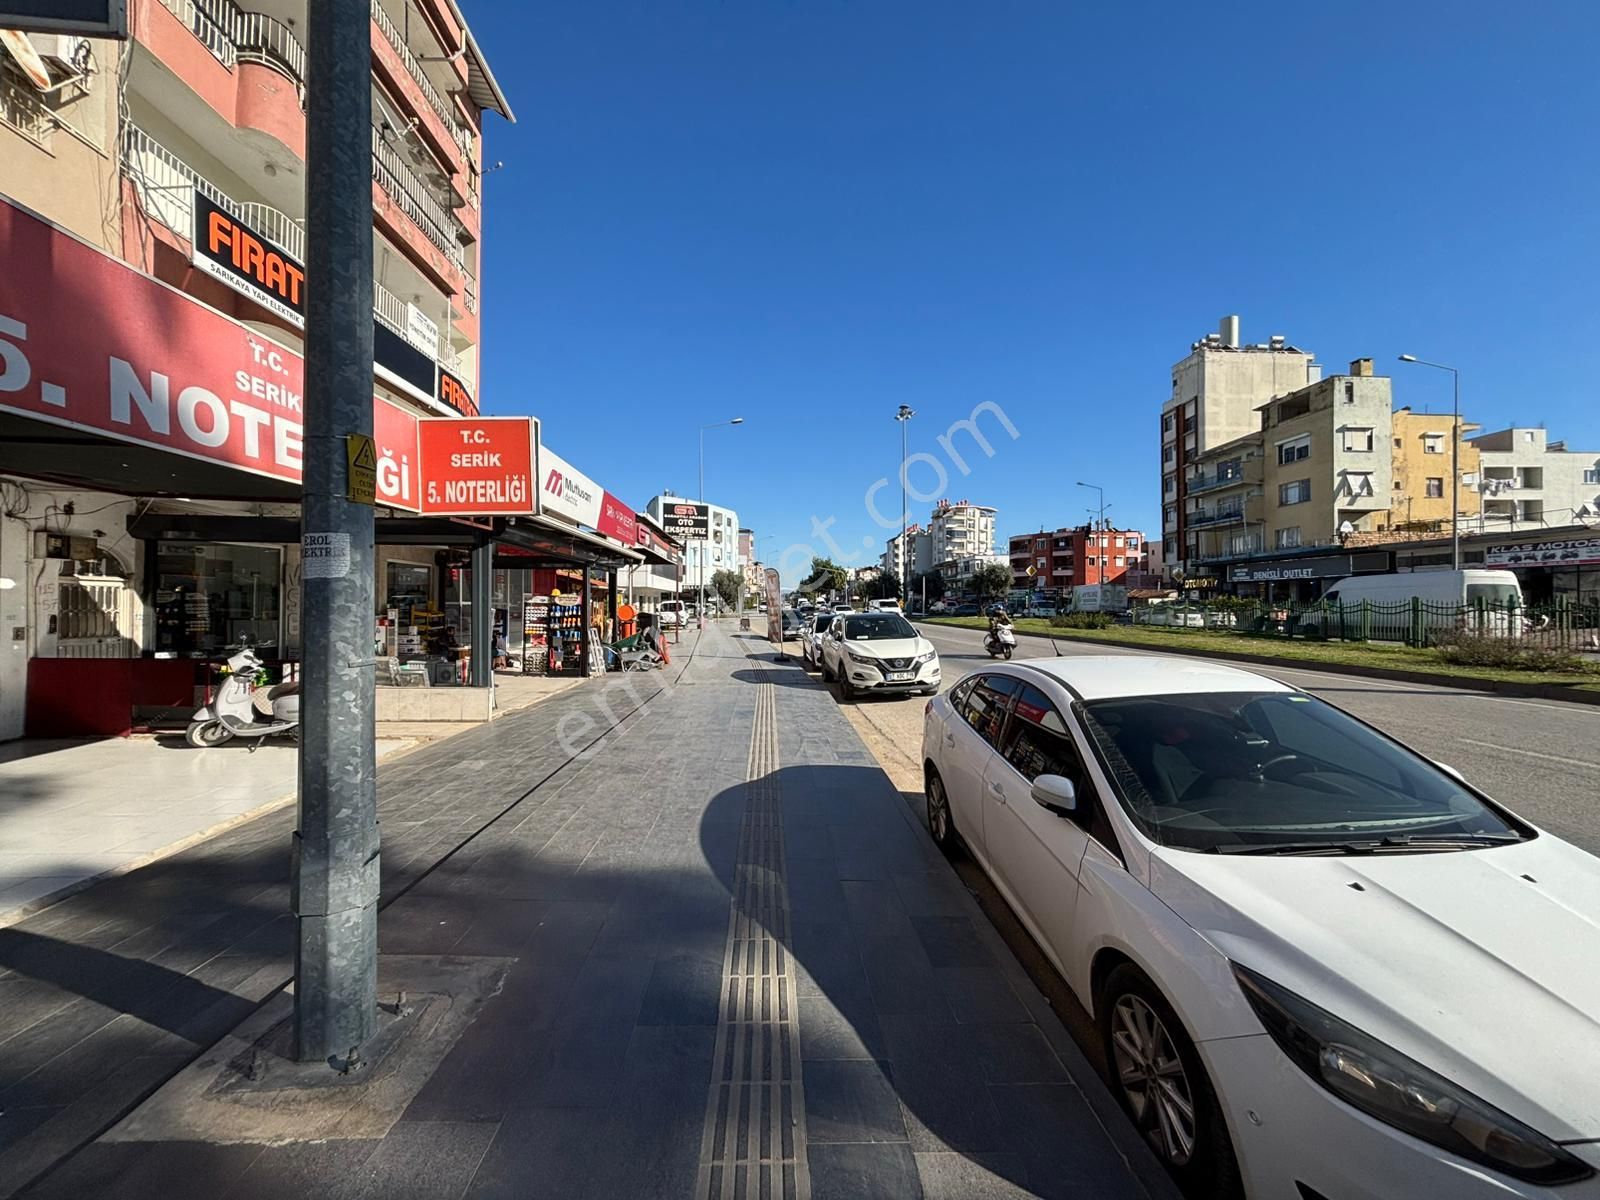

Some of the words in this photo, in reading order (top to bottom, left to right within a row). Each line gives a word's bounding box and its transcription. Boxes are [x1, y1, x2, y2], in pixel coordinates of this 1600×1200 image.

[209, 211, 304, 305] FIRAT
[210, 263, 250, 294] SARIKAYA
[252, 288, 269, 303] YAPI
[252, 343, 290, 376] T.C.
[235, 370, 303, 415] SERİK
[460, 429, 491, 444] T.C.
[450, 451, 502, 467] SERİK
[427, 481, 441, 503] 5.
[445, 475, 526, 503] NOTERLİĞİ
[1491, 545, 1533, 554] KLAS
[1283, 568, 1313, 578] OUTLET
